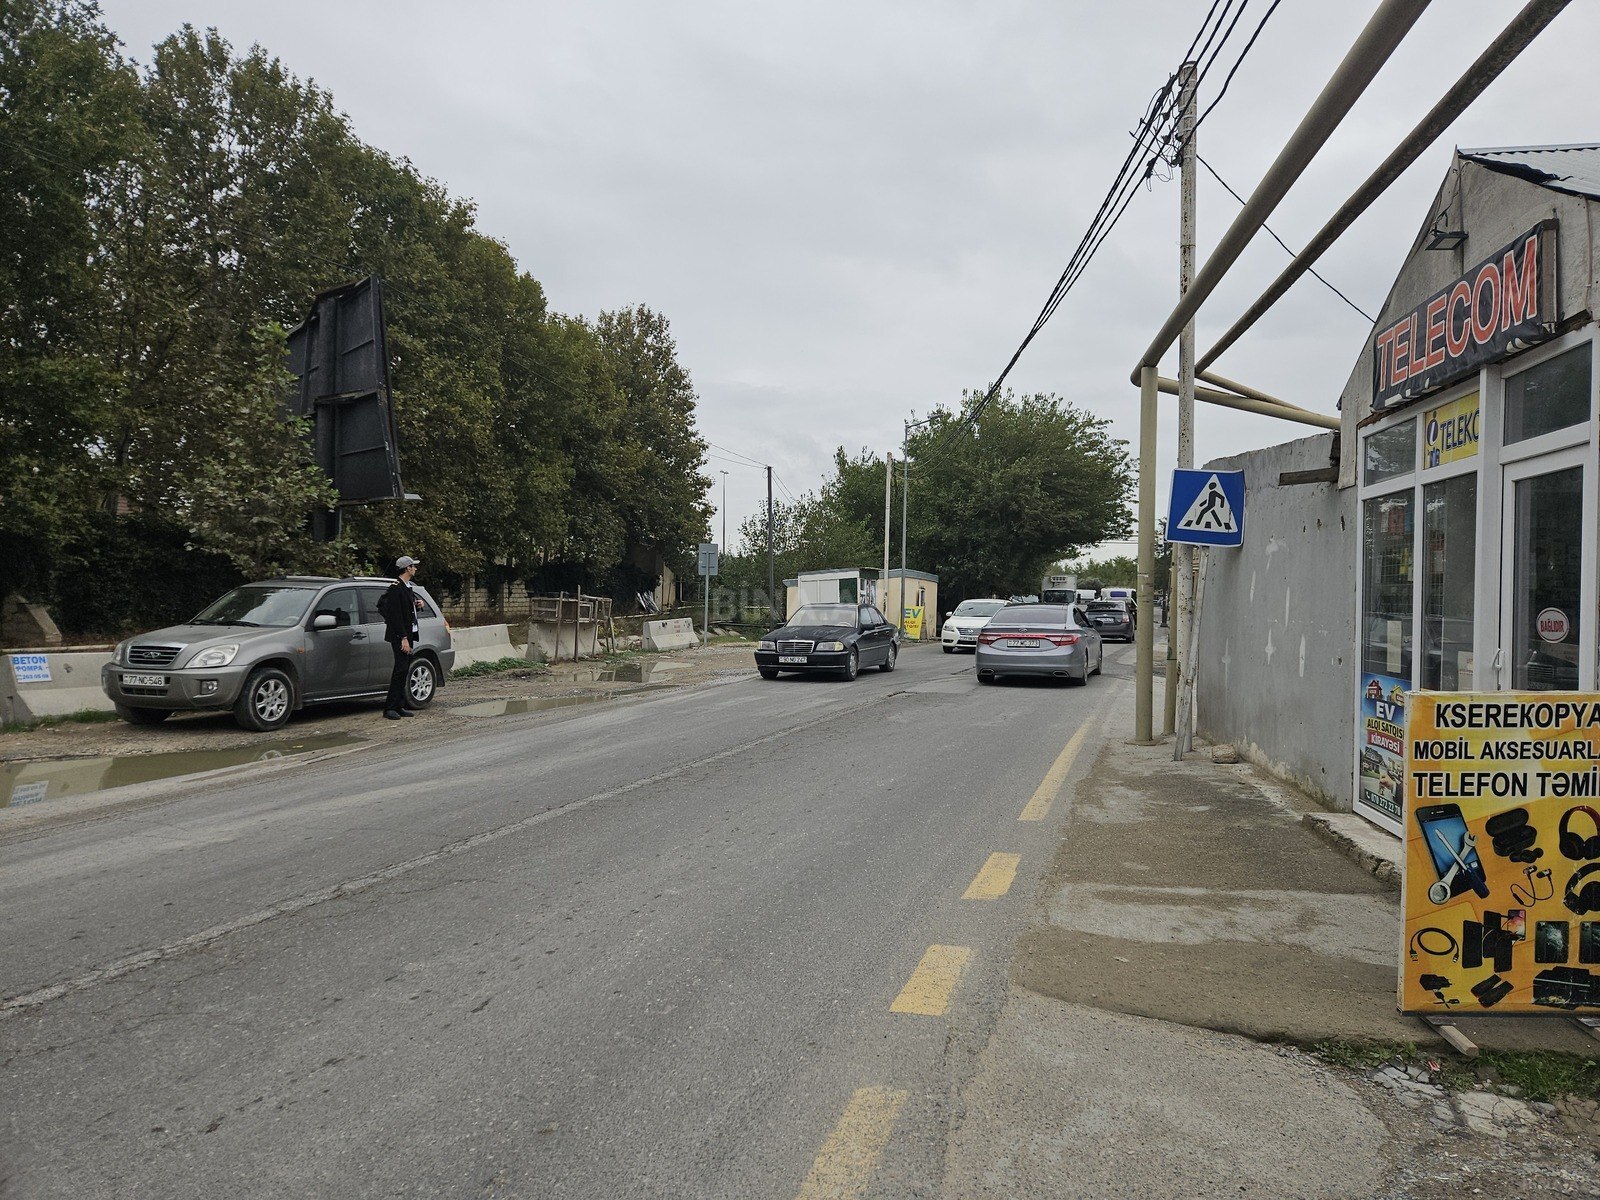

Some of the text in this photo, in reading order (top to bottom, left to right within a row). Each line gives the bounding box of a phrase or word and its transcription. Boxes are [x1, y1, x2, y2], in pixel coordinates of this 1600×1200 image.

[1377, 234, 1538, 393] TELECOM
[1540, 618, 1564, 632] BAĞLIDIR
[13, 656, 46, 665] BETON
[1376, 701, 1395, 721] EV
[1367, 718, 1380, 731] ALQI
[1414, 737, 1600, 760] MOBİL AKSESUARL
[1413, 766, 1600, 798] TELEFON TƏMİ
